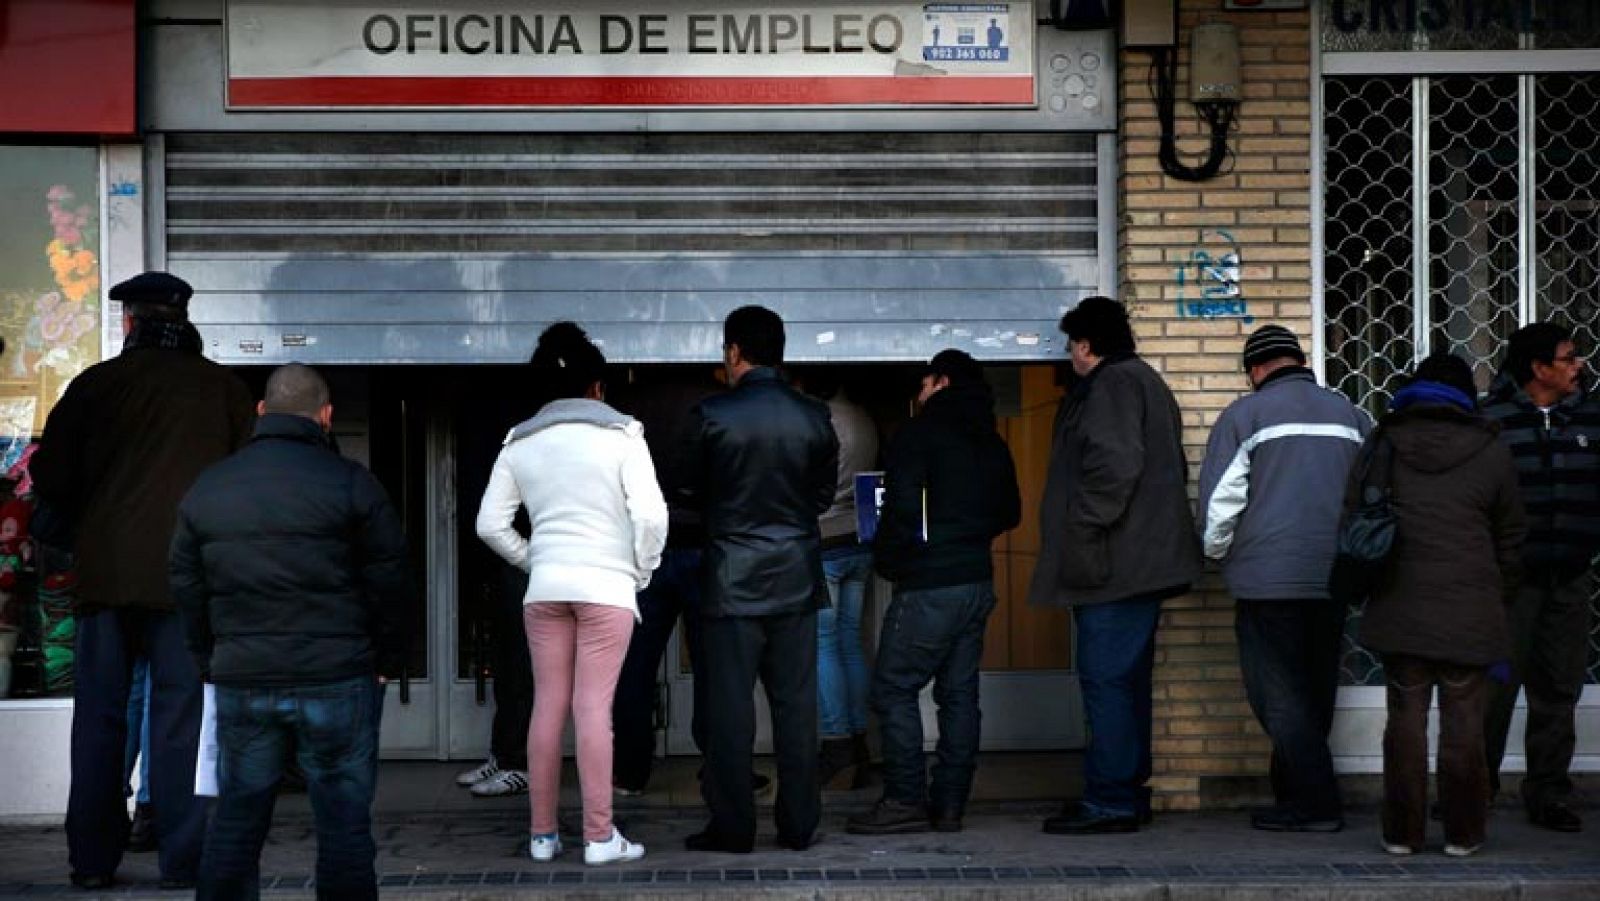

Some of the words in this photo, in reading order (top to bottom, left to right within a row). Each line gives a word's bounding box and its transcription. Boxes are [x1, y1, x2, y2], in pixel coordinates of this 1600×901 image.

[362, 14, 583, 54] OFICINA
[599, 14, 669, 54] DE
[688, 14, 904, 54] EMPLEO
